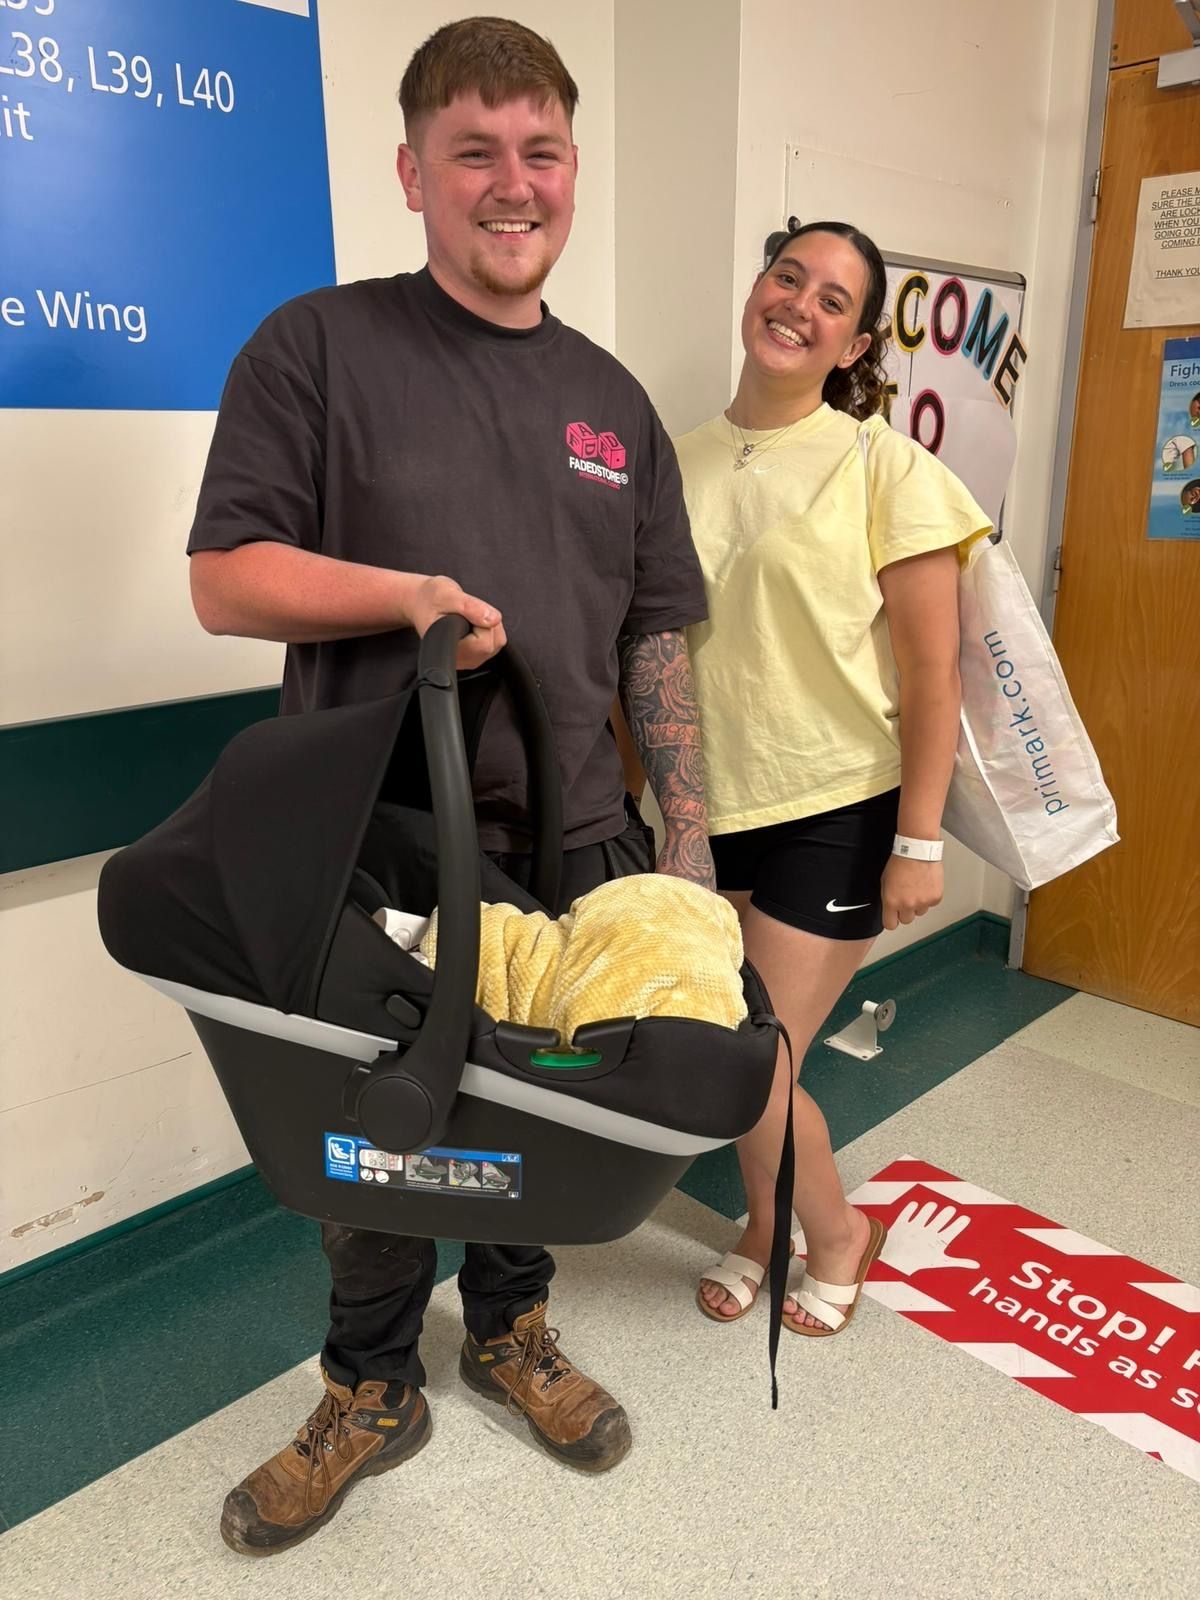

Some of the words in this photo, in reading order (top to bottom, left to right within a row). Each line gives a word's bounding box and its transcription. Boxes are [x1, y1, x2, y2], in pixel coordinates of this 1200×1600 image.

[88, 46, 162, 107] L39,
[175, 63, 235, 113] L40
[1161, 187, 1192, 199] PLEASE
[1151, 199, 1175, 209] SURE
[1177, 197, 1192, 207] THE
[1160, 209, 1178, 218] ARE
[1154, 219, 1180, 229] WHEN
[1182, 217, 1200, 227] YOU
[1154, 229, 1181, 239] GOING
[1161, 238, 1195, 248] COMING
[1156, 269, 1183, 278] THANK
[1, 297, 26, 326] e
[36, 289, 147, 342] Wing
[880, 271, 1027, 409] COME
[983, 630, 1069, 816] primark.com
[1009, 1260, 1176, 1354] Stop!
[968, 1277, 1100, 1357] hands
[1108, 1355, 1162, 1389] as
[1170, 1387, 1200, 1415] s
